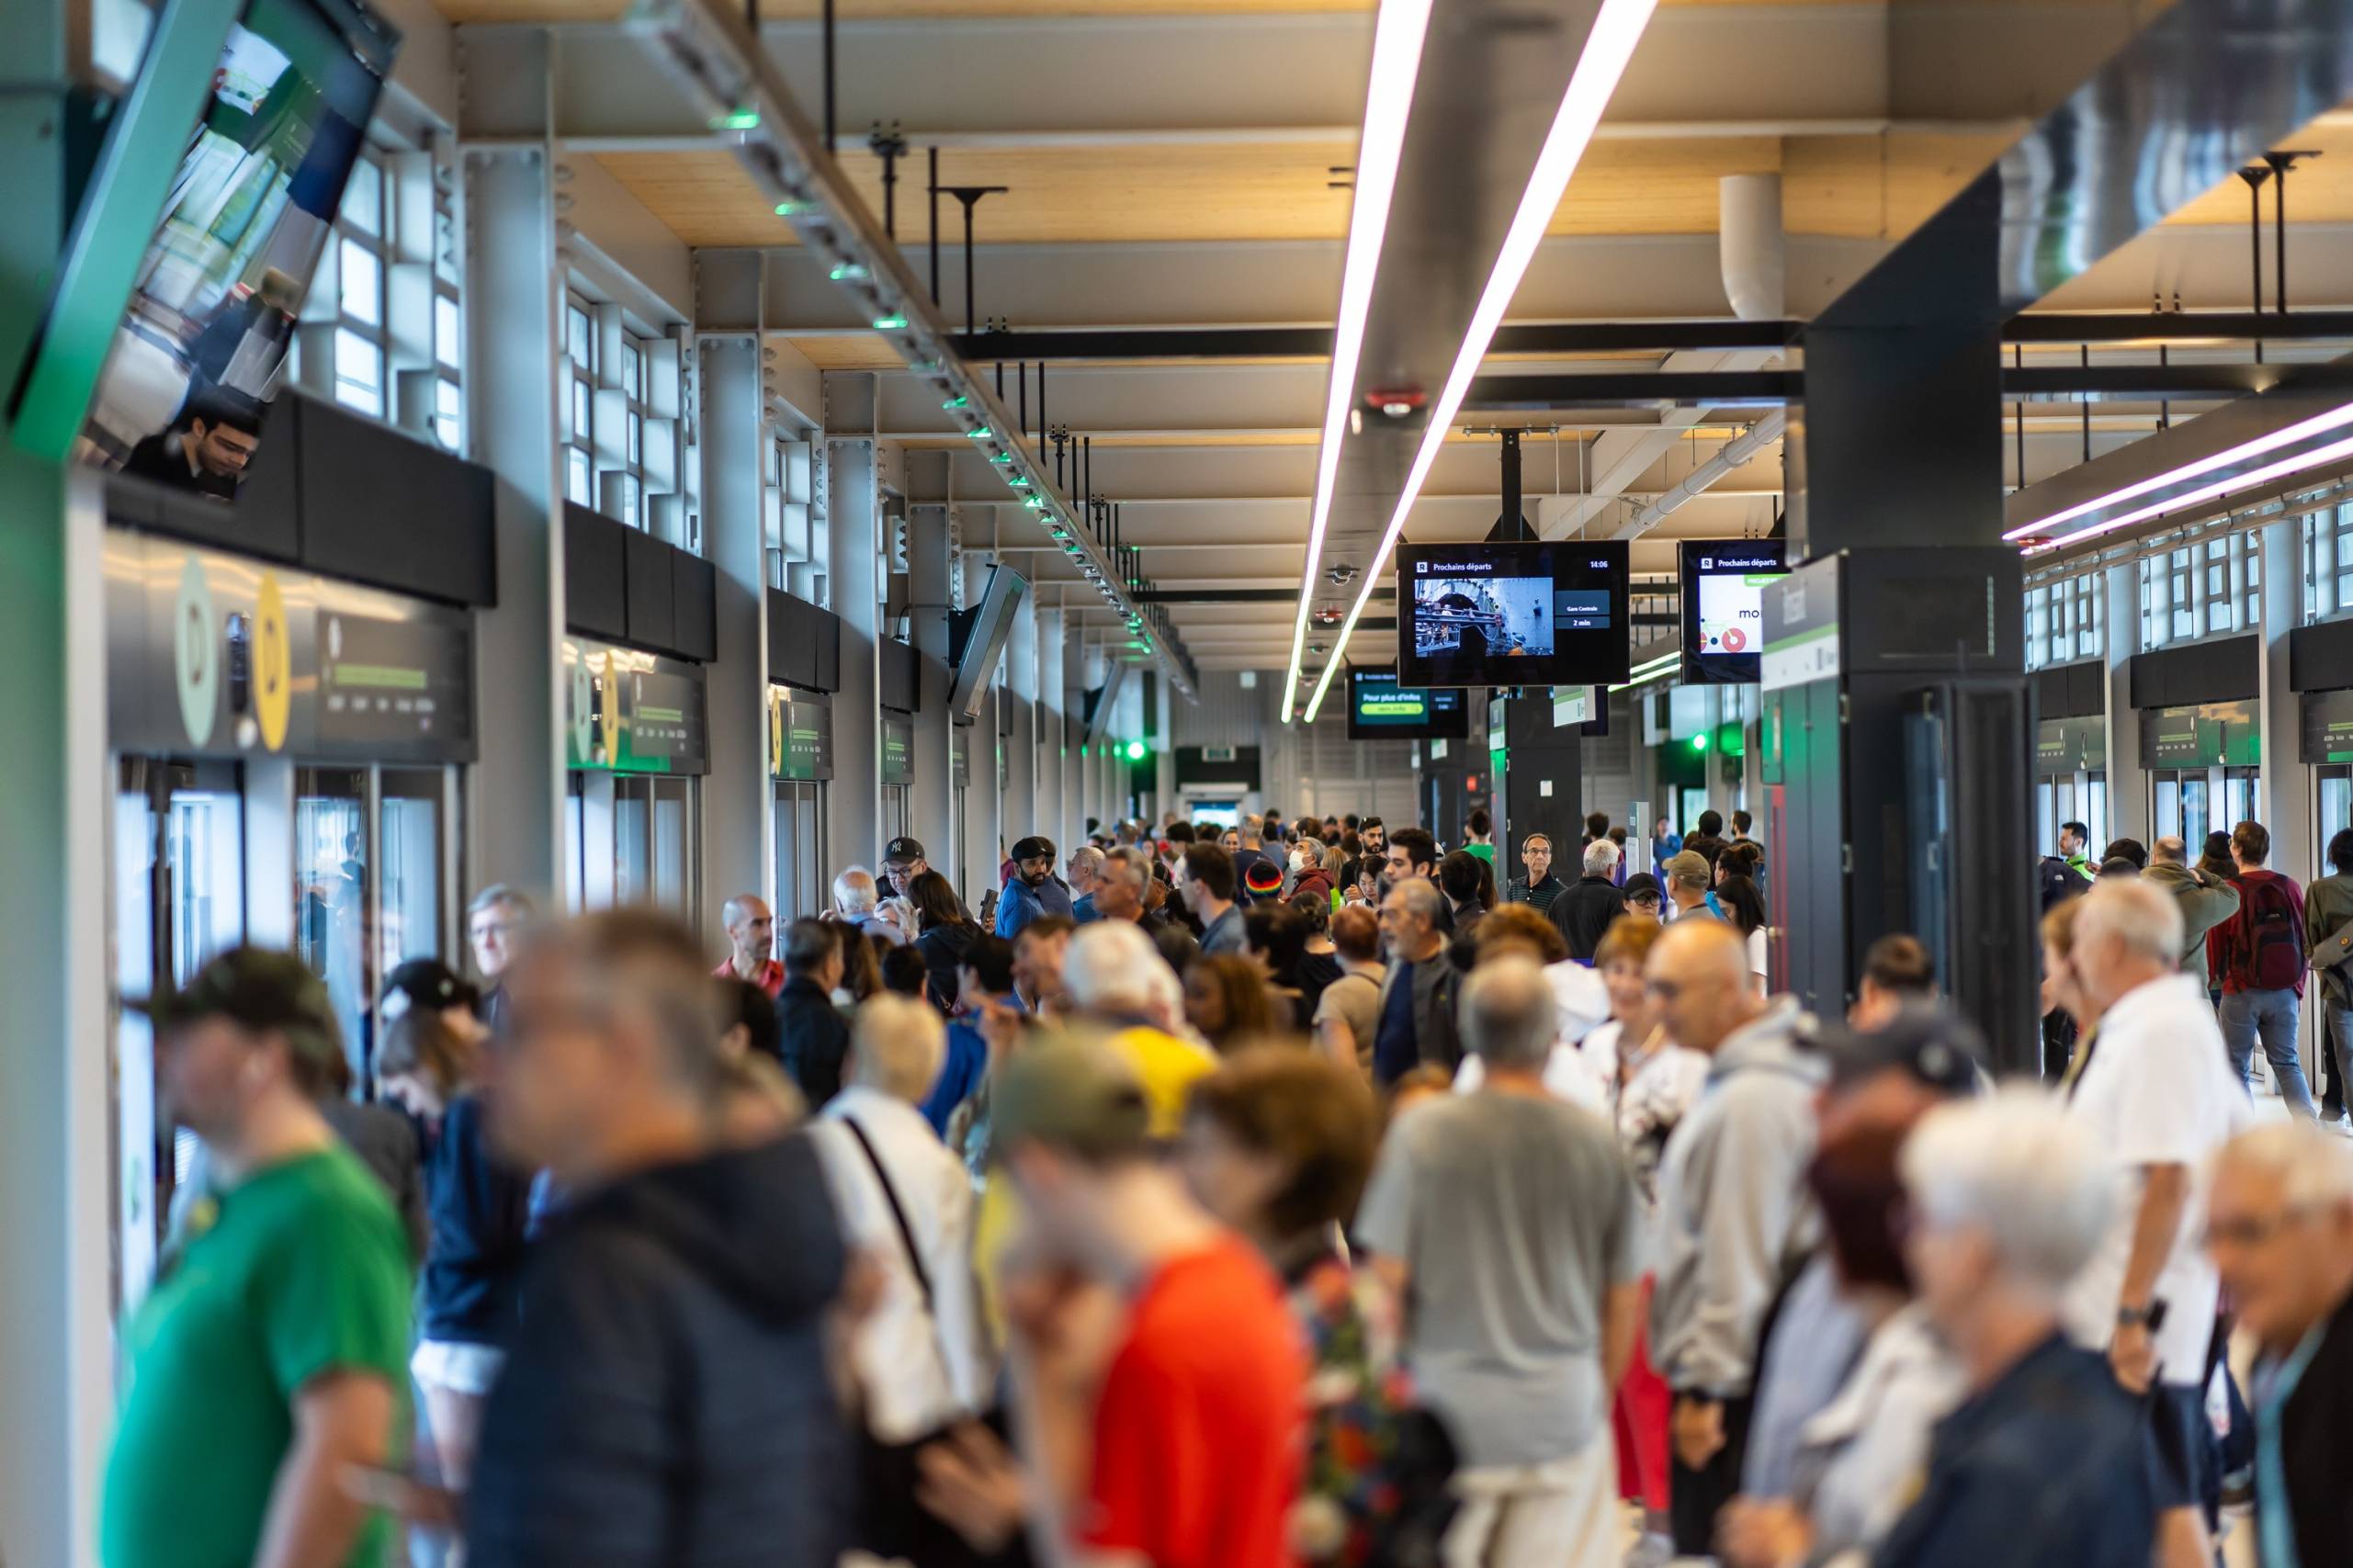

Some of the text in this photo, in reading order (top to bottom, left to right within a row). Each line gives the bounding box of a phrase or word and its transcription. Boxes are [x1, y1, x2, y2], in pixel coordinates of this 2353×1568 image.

[1466, 563, 1492, 571] départs
[1751, 558, 1777, 568] départs
[1739, 610, 1763, 618] mo
[1363, 694, 1379, 702] Pour
[1381, 694, 1396, 703] plus
